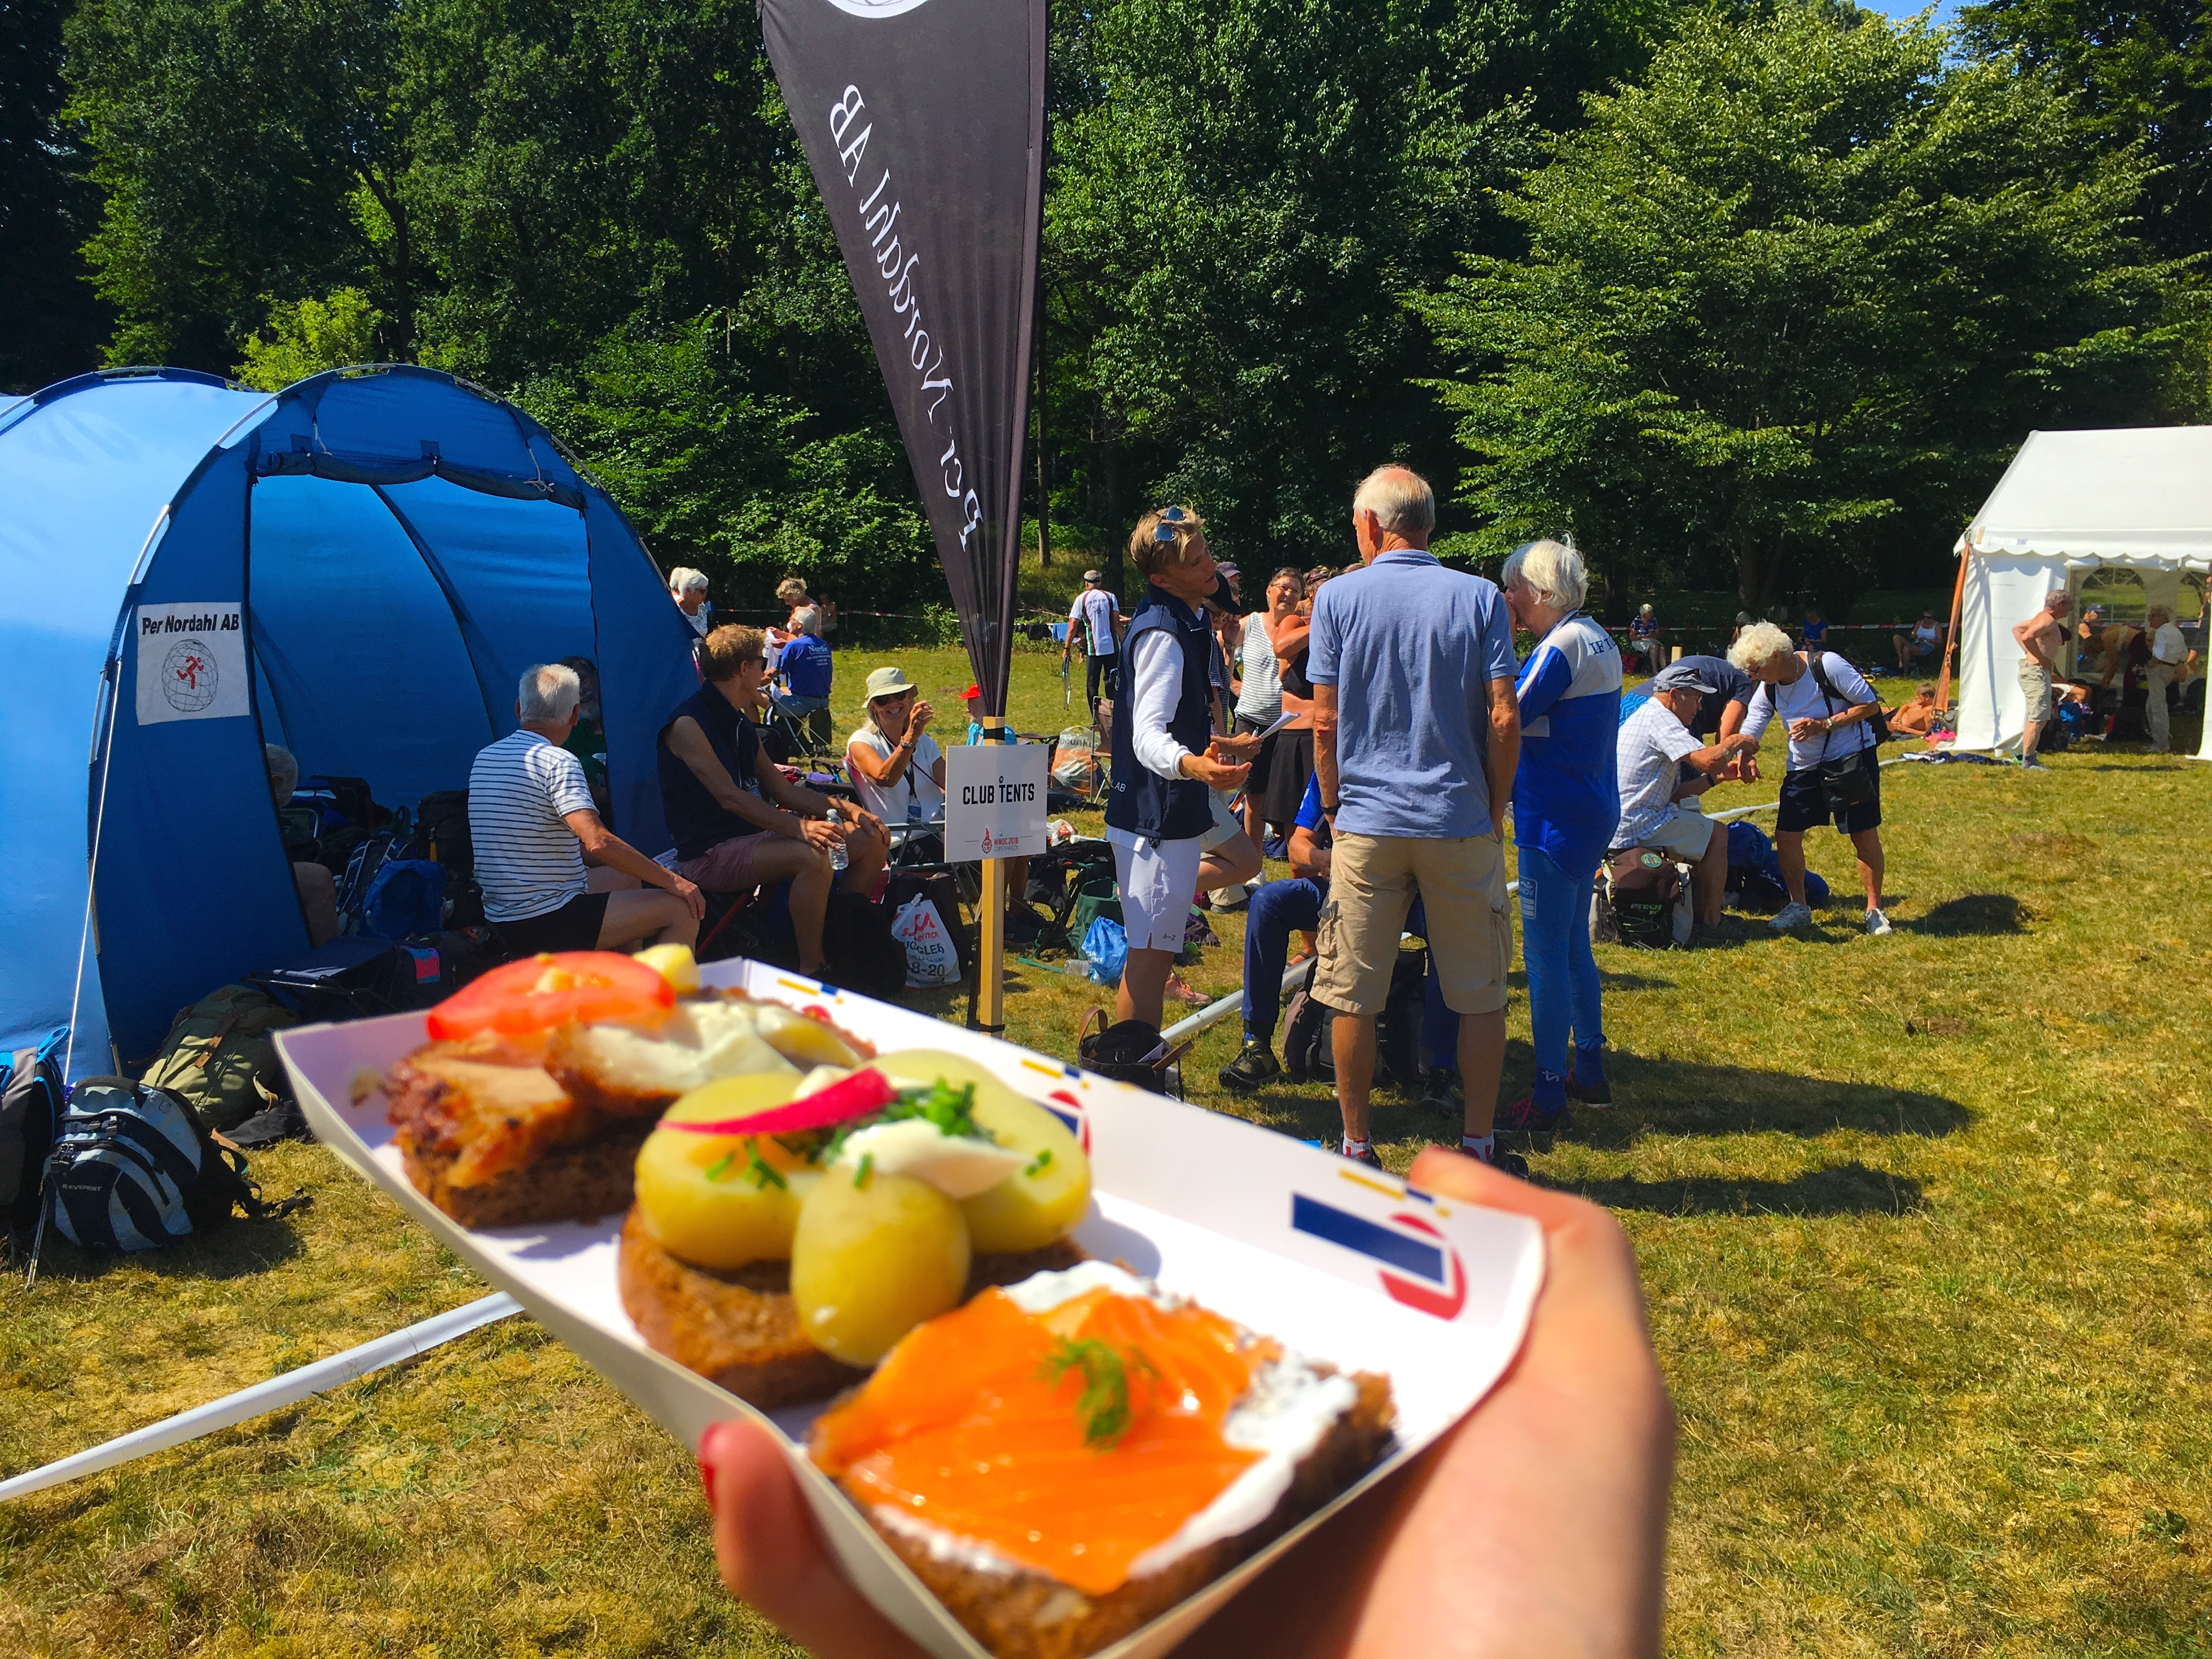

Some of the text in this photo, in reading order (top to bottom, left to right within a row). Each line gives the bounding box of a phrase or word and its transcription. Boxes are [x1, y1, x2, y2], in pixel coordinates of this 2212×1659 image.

[142, 613, 239, 635] Per Nordahl AB
[963, 783, 1035, 805] CLUB TENTS
